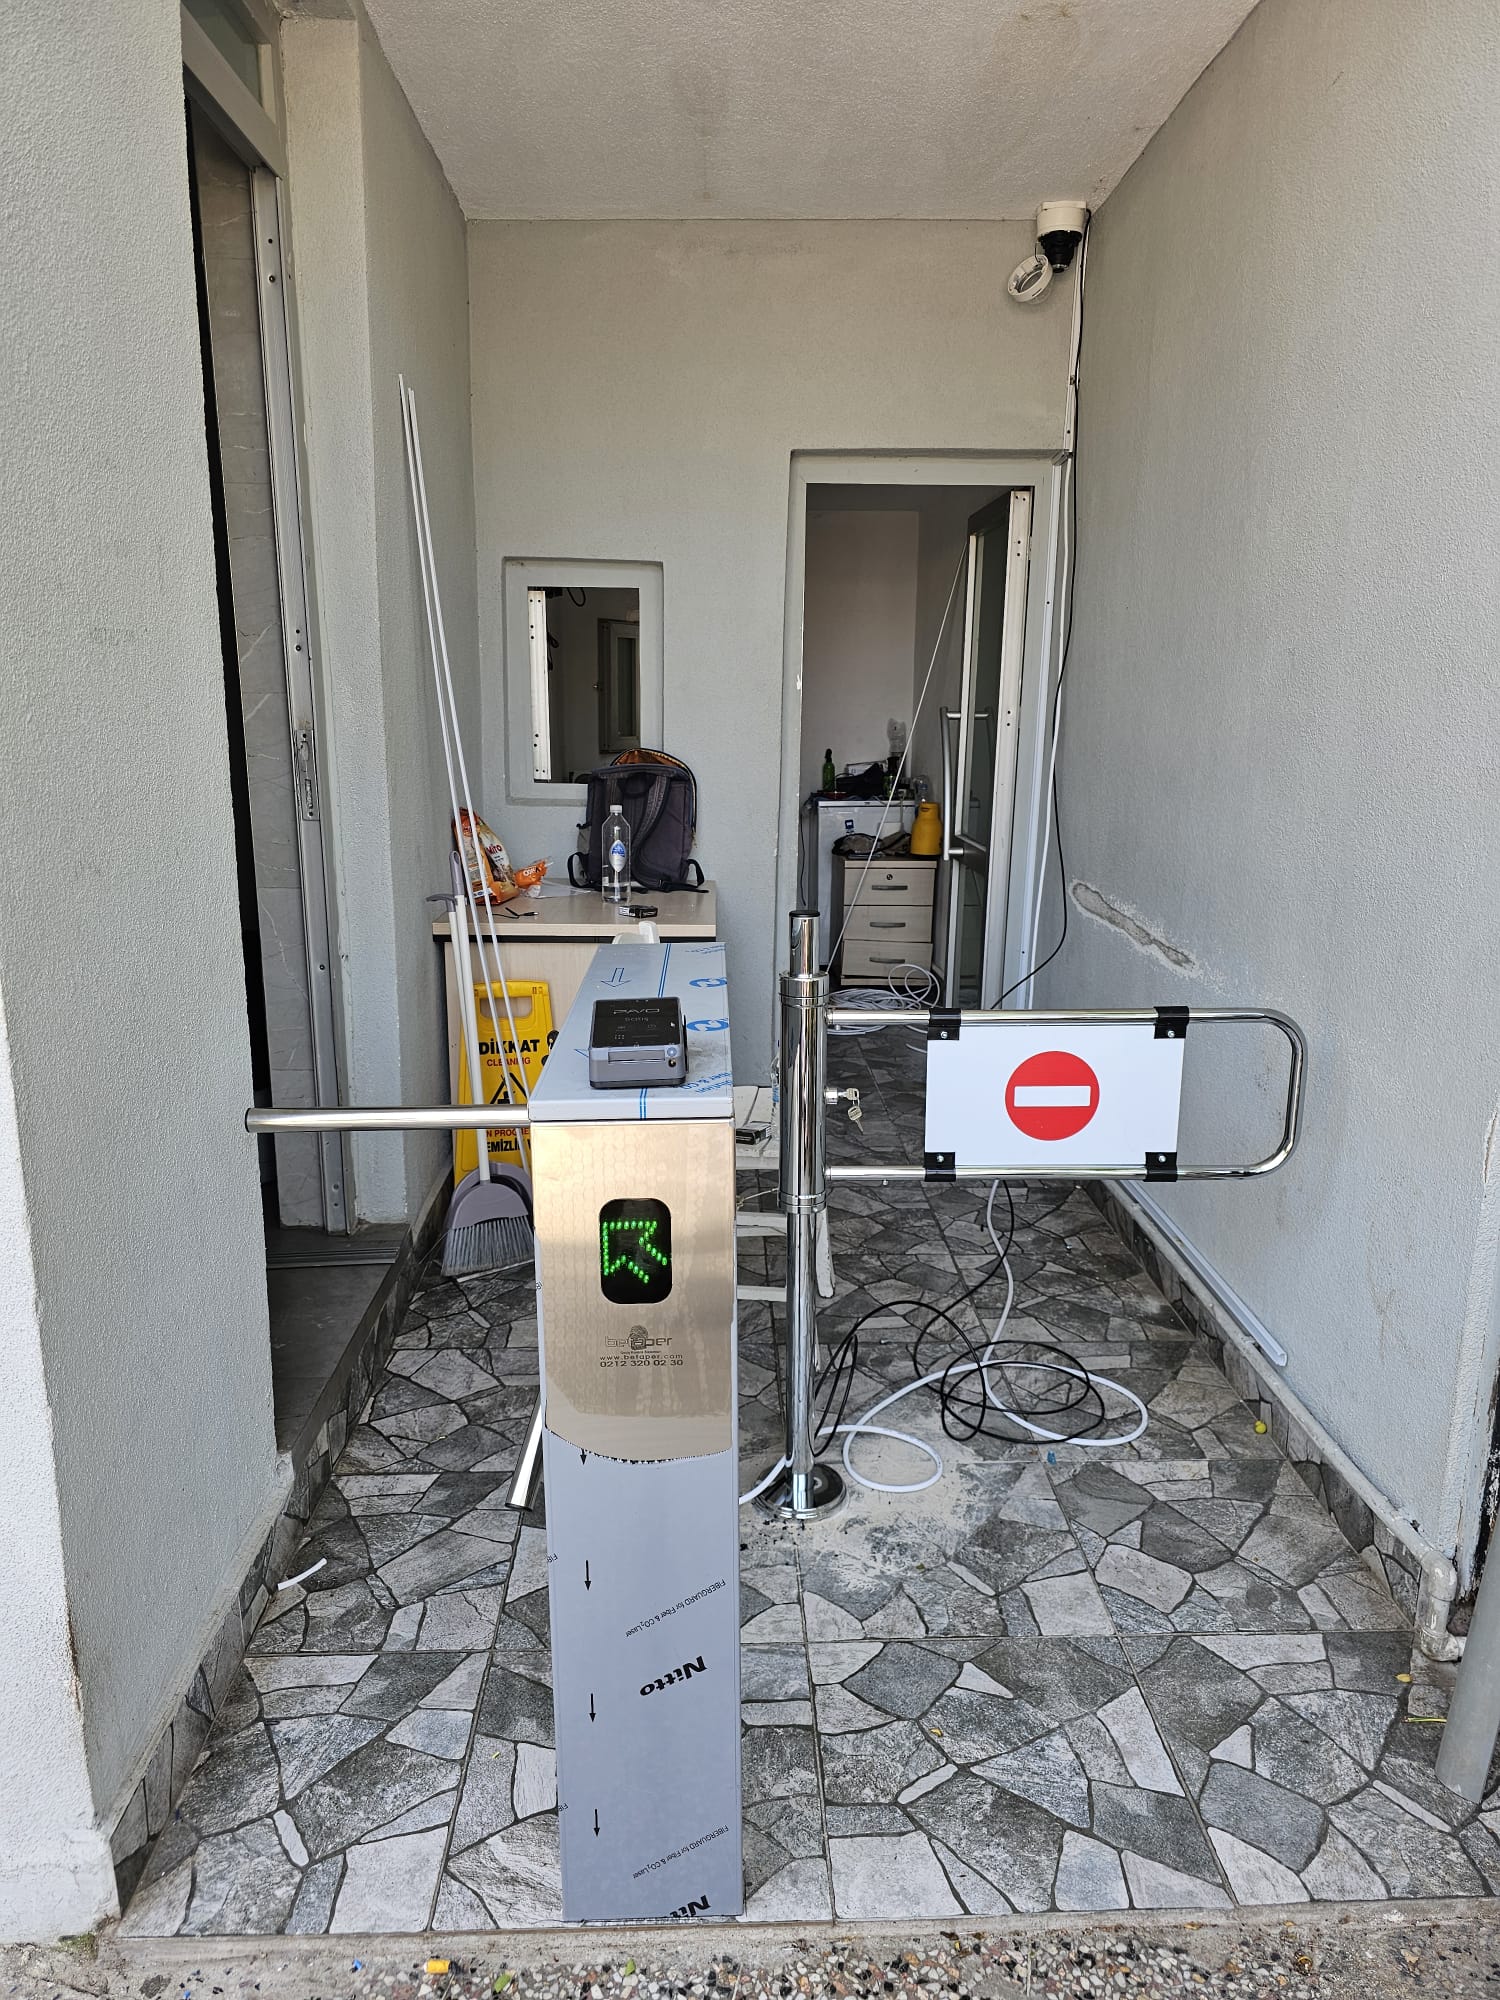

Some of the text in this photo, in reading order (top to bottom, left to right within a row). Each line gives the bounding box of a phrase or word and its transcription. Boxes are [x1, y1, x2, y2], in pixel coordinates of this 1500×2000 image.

[479, 1038, 541, 1055] DİKKAT
[486, 1137, 520, 1152] EMİZLİ
[605, 1336, 673, 1348] betaper
[684, 1579, 727, 1606] FIBERGUARD
[675, 1601, 685, 1609] for
[660, 1606, 677, 1618] Fiber
[625, 1624, 643, 1637] Laser
[640, 1656, 708, 1696] Nitto
[689, 1824, 729, 1850] FIBERGUARD
[666, 1850, 682, 1861] Fiber
[632, 1867, 650, 1879] Laser
